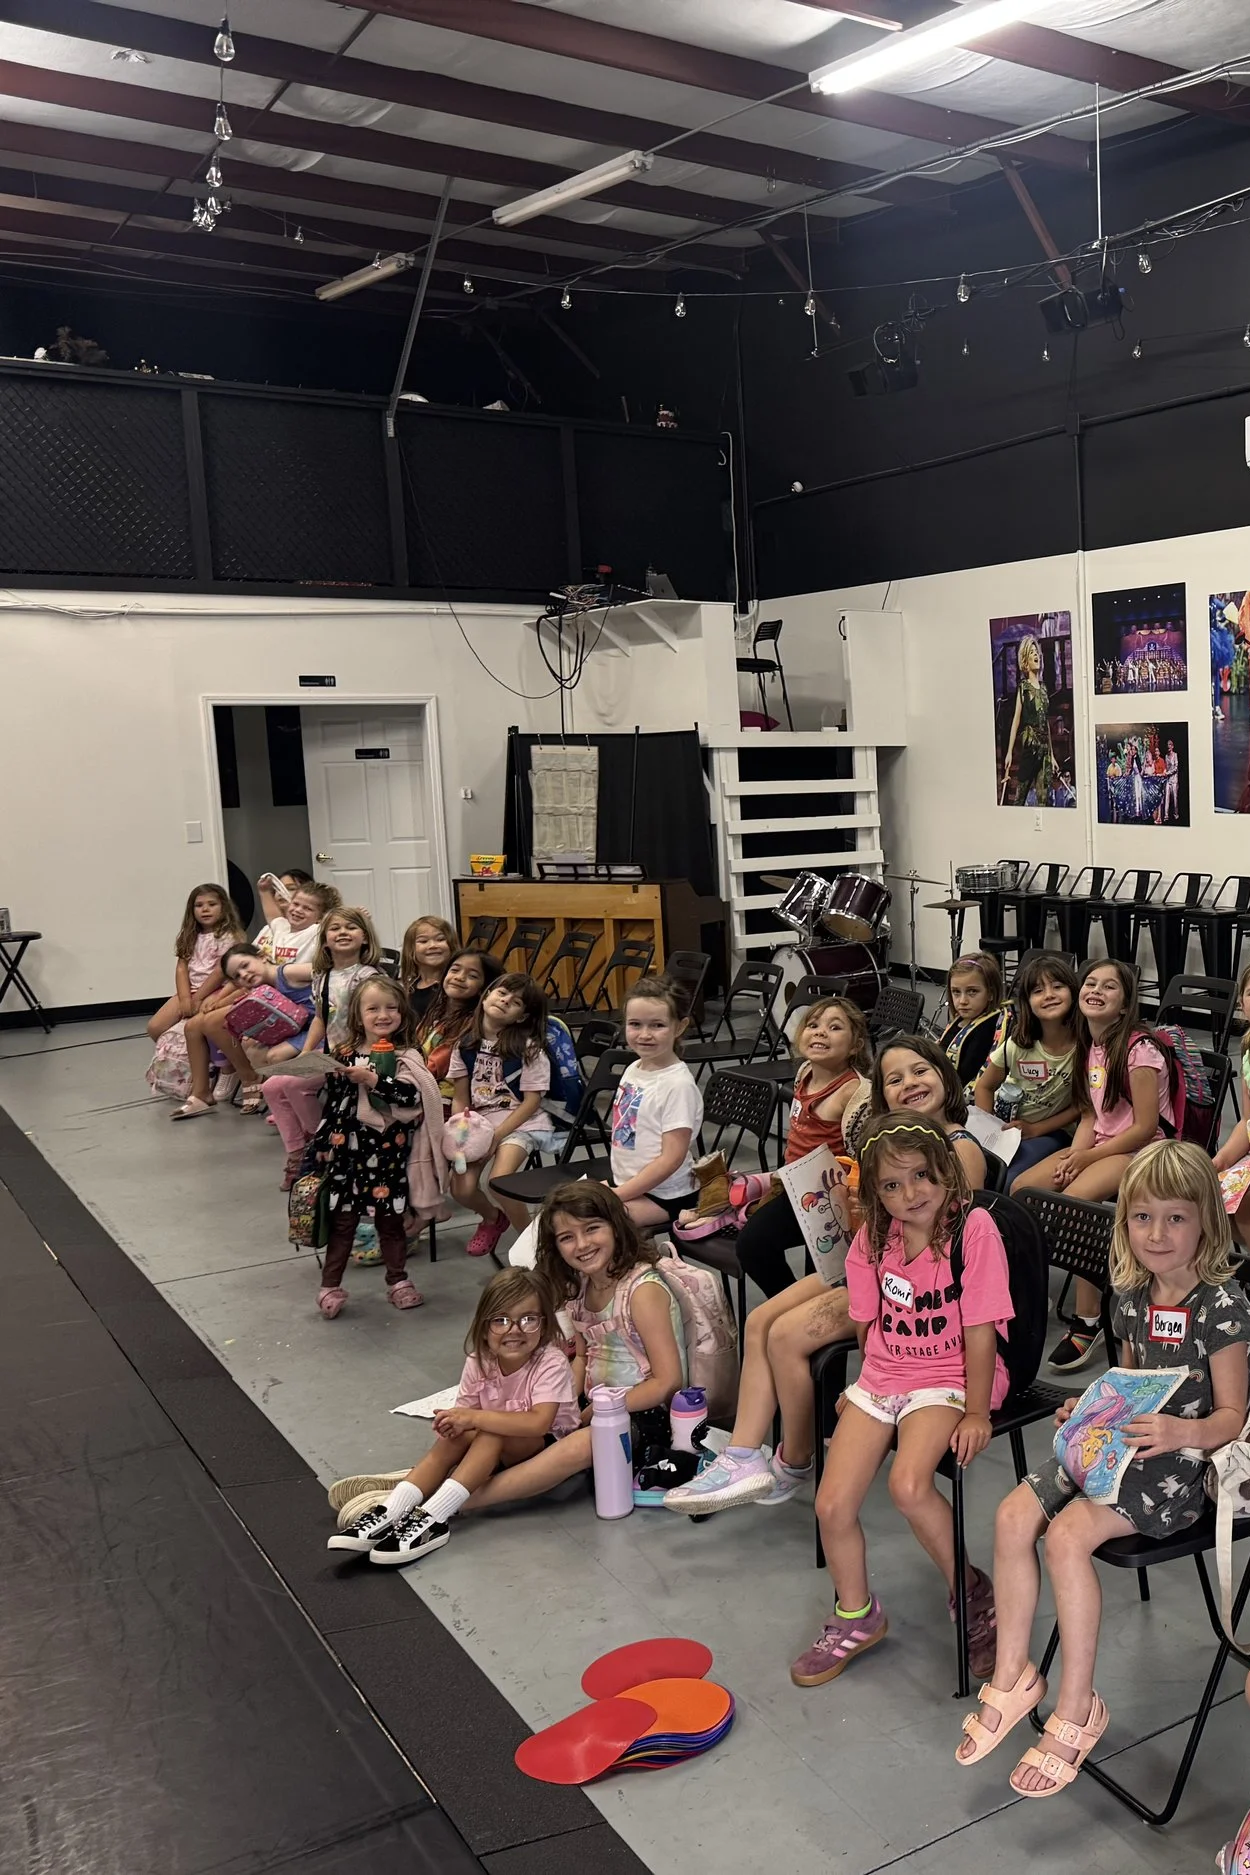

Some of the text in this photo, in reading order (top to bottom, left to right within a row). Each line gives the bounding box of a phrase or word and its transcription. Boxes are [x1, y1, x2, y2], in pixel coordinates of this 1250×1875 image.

[1022, 1066, 1039, 1077] Lucy
[884, 1277, 911, 1302] Romi
[883, 1314, 947, 1337] CAMP
[905, 1344, 939, 1357] STAGE
